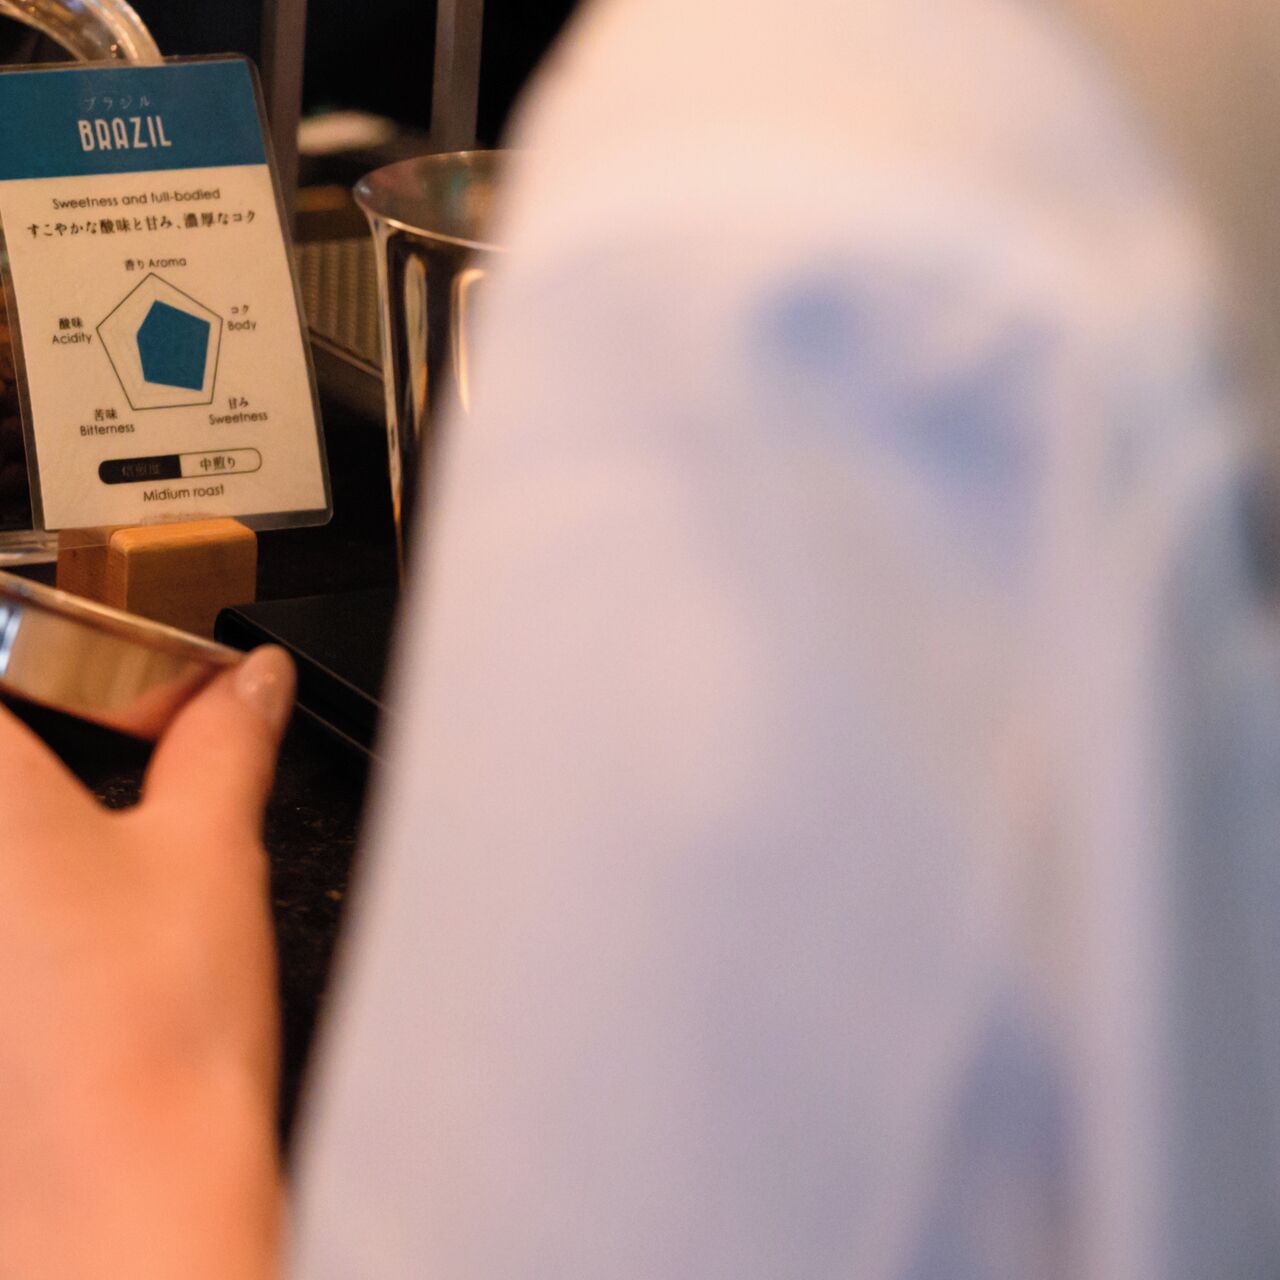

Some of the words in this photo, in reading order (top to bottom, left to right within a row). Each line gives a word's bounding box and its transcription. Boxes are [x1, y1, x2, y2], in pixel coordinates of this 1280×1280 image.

[78, 115, 172, 152] BRAZIL
[52, 195, 118, 210] Sweetness
[122, 192, 147, 205] and
[151, 188, 220, 203] full-bodied
[125, 258, 144, 271] 香り
[148, 257, 186, 268] Aroma
[231, 304, 249, 315] コク
[228, 319, 256, 332] Body
[52, 333, 92, 346] Acidity
[228, 397, 249, 409] 甘み
[209, 411, 268, 426] Sweetness
[80, 423, 135, 436] Bitterness
[199, 455, 236, 471] 中煎り
[143, 487, 190, 502] Midium
[193, 484, 225, 497] roast
